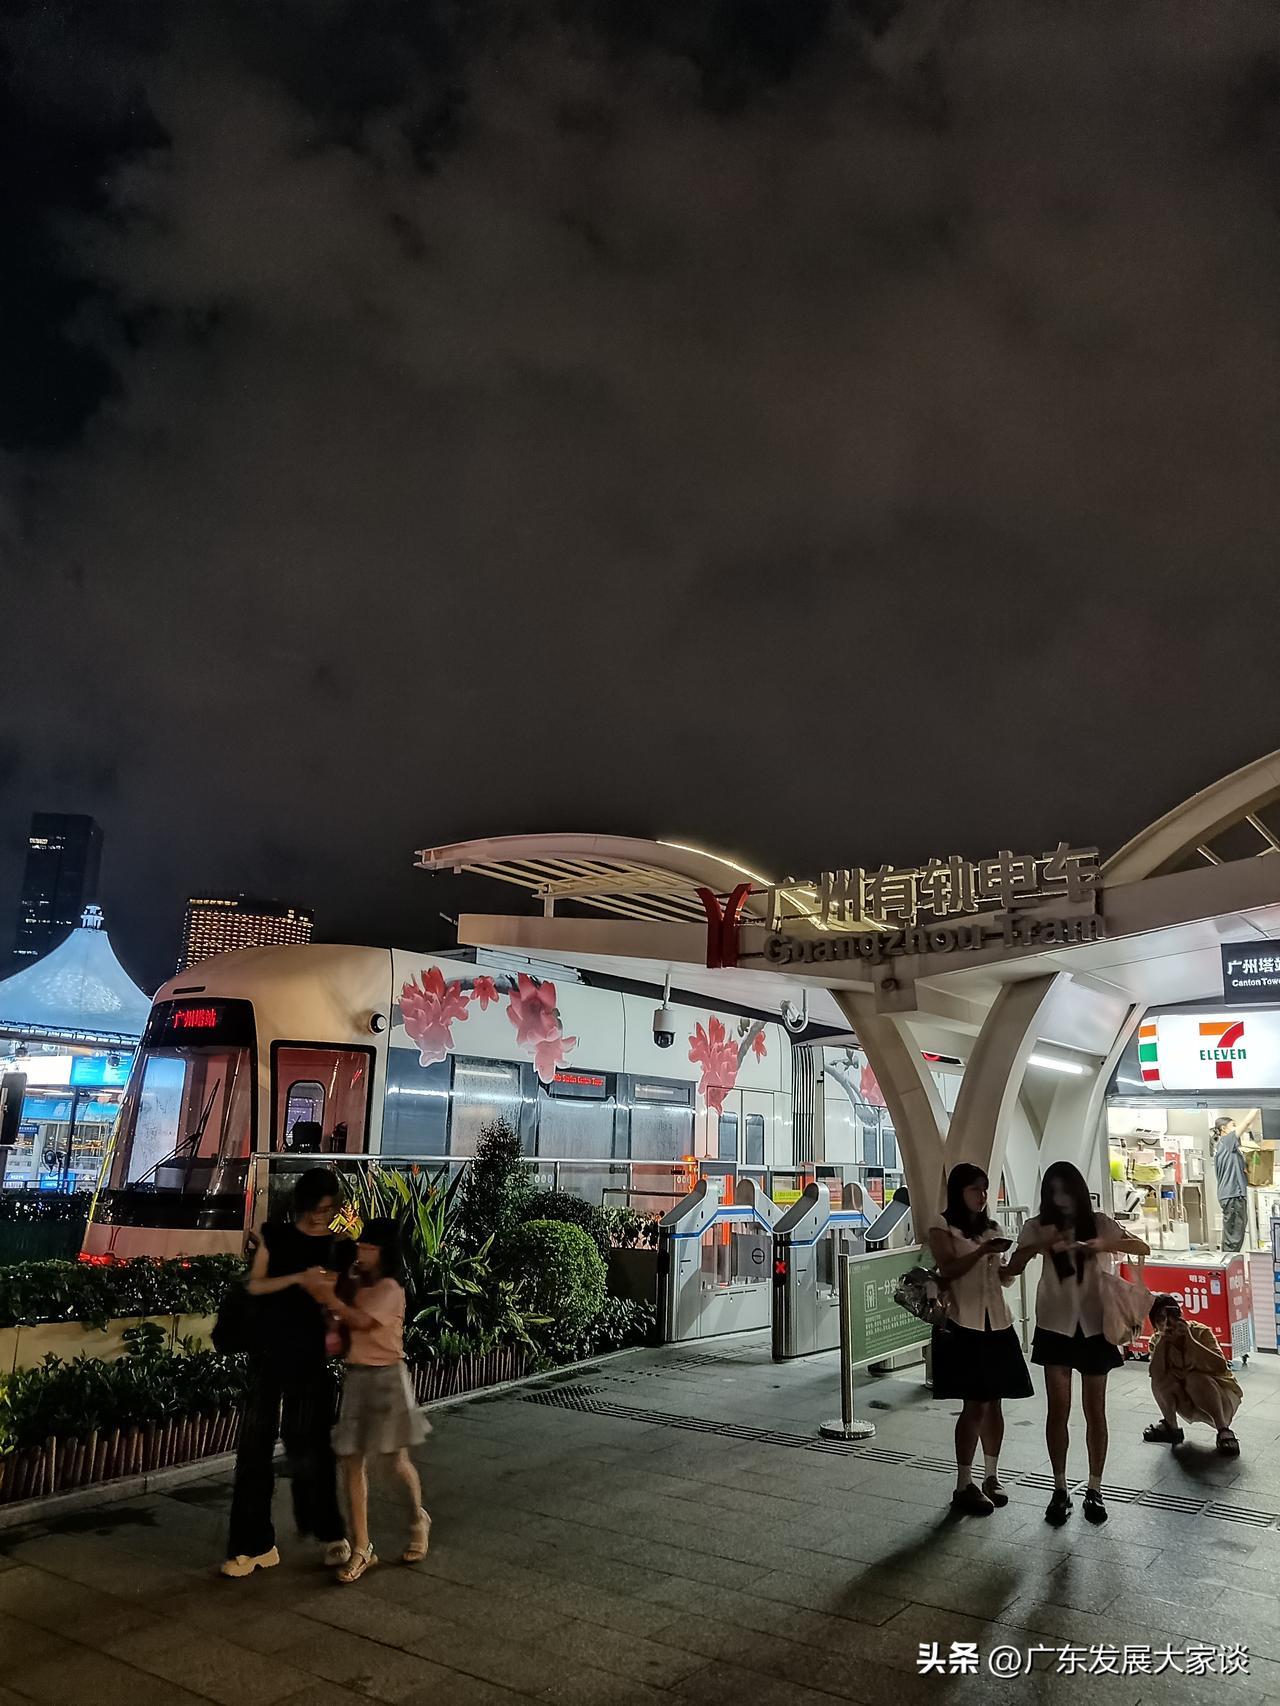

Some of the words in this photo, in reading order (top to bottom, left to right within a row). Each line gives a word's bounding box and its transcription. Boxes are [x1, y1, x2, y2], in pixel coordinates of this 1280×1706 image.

[764, 841, 1102, 931] 广州有轨电车
[763, 923, 986, 964] Guangzhou
[994, 912, 1106, 945] Tram
[1199, 1021, 1244, 1079] 7
